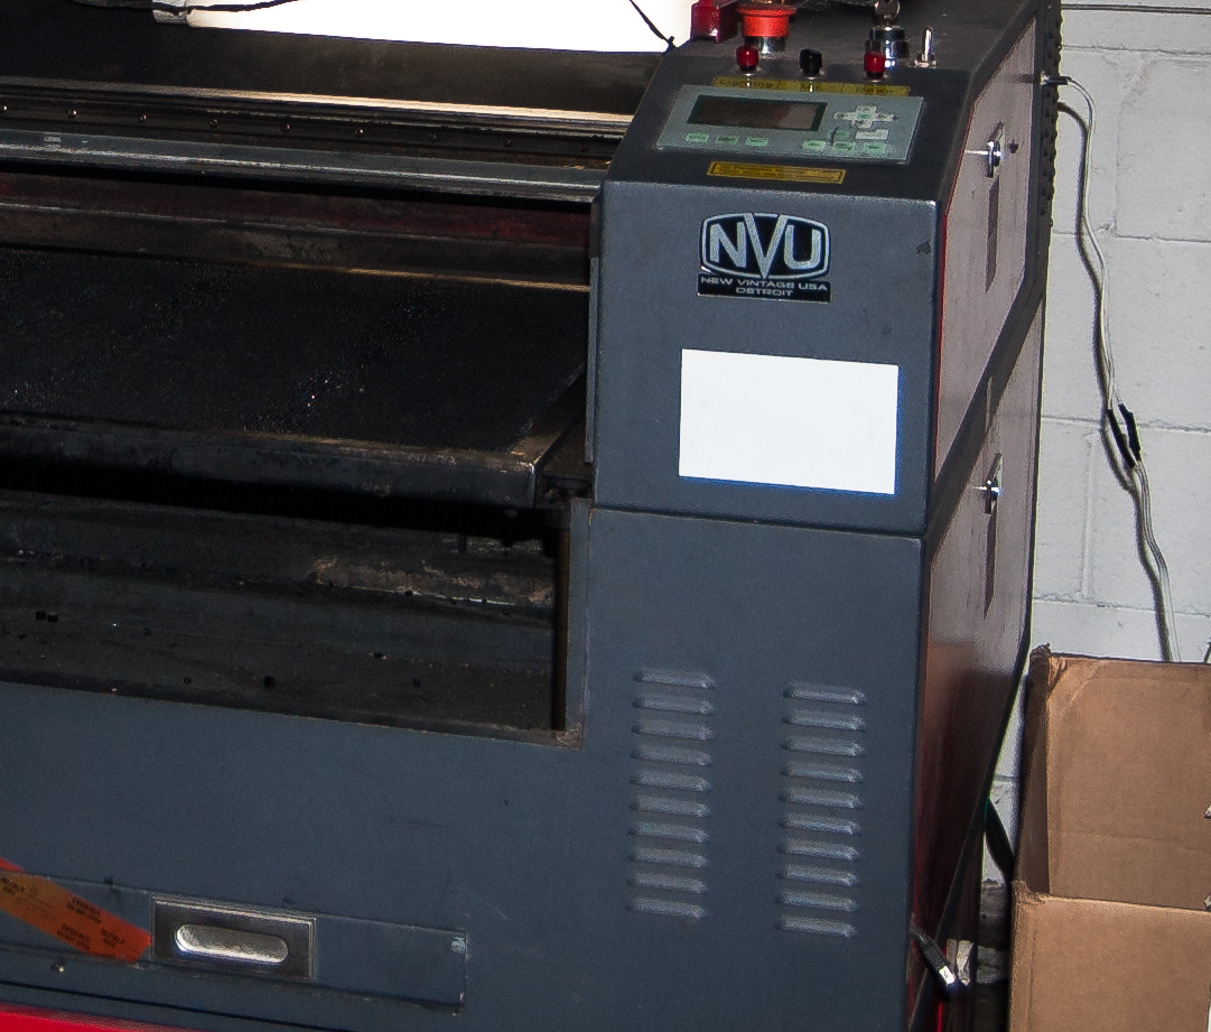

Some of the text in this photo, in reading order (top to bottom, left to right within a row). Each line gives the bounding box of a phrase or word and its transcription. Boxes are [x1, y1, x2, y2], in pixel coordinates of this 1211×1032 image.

[709, 212, 822, 279] NVU
[700, 276, 829, 291] NEW VINTAGE USA
[735, 286, 794, 297] DETROIT
